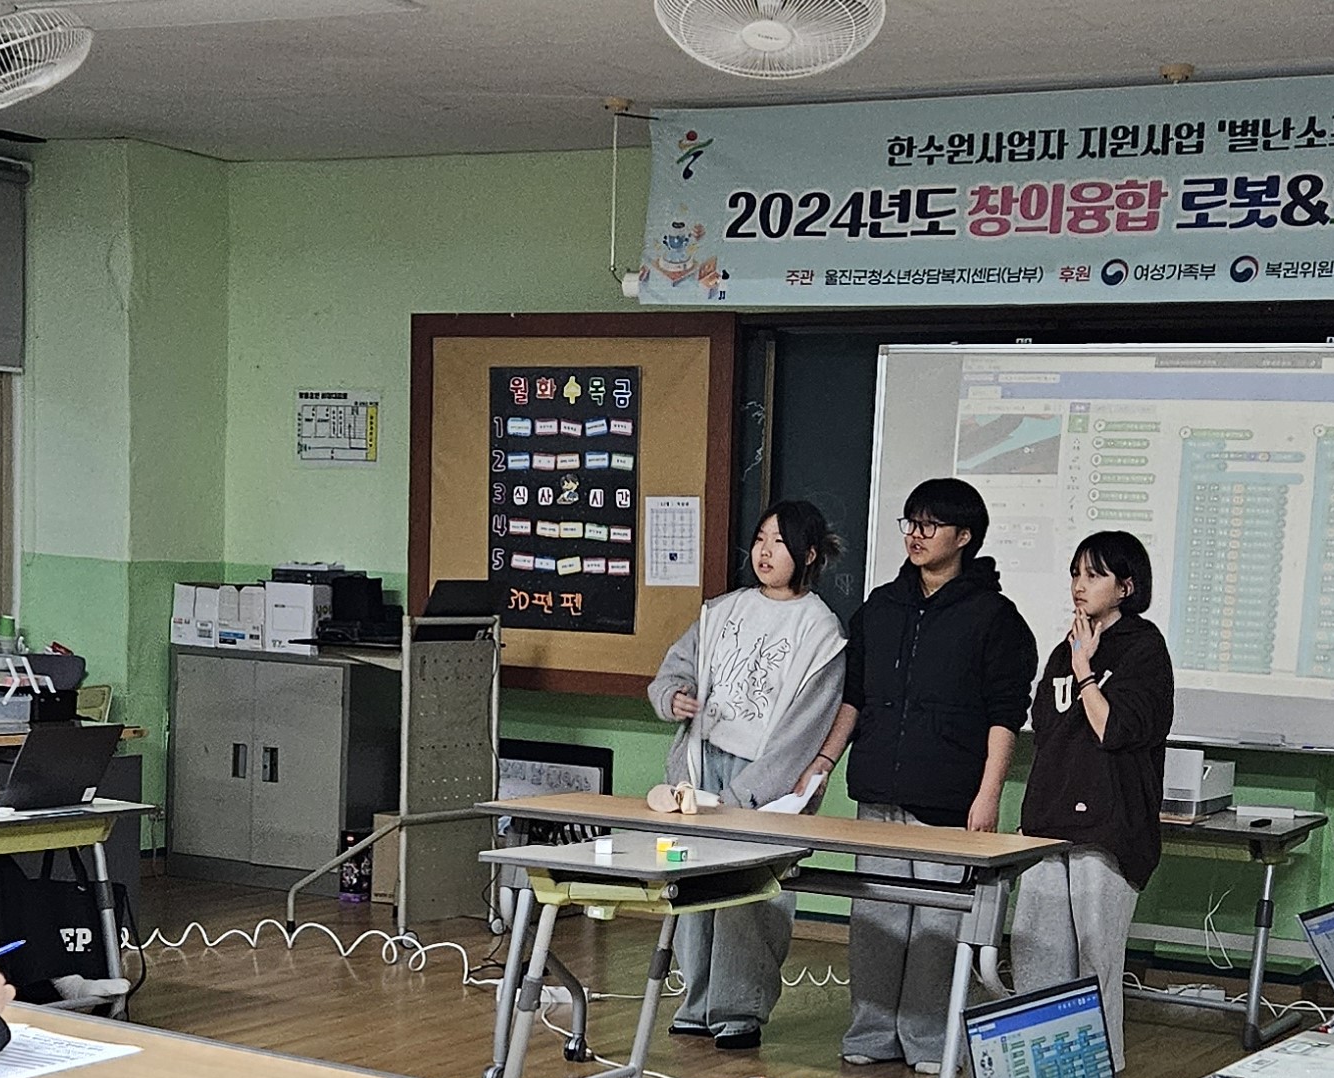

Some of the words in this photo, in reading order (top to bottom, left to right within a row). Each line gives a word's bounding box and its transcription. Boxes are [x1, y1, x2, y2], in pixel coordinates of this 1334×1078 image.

[886, 127, 1069, 167] 한수원사업자
[1076, 121, 1206, 160] 지원사업
[725, 187, 958, 239] 2024년도
[967, 178, 1168, 238] 창의융합
[785, 269, 814, 286] 주관
[824, 266, 1044, 286] 울진군청소년상담복지센터(남부)
[1059, 265, 1091, 283] 후원
[1133, 262, 1216, 281] 여성가족부
[509, 376, 529, 405] 월
[536, 377, 557, 400] 화
[563, 375, 582, 405] 수
[588, 377, 606, 406] 목
[613, 378, 632, 409] 금
[494, 416, 503, 438] 1
[492, 450, 506, 472] 2
[492, 482, 507, 504] 3
[514, 486, 528, 505] 식
[538, 486, 553, 505] 사
[589, 489, 604, 507] 시
[616, 489, 630, 508] 간
[492, 514, 507, 536] 4
[492, 548, 505, 570] 5
